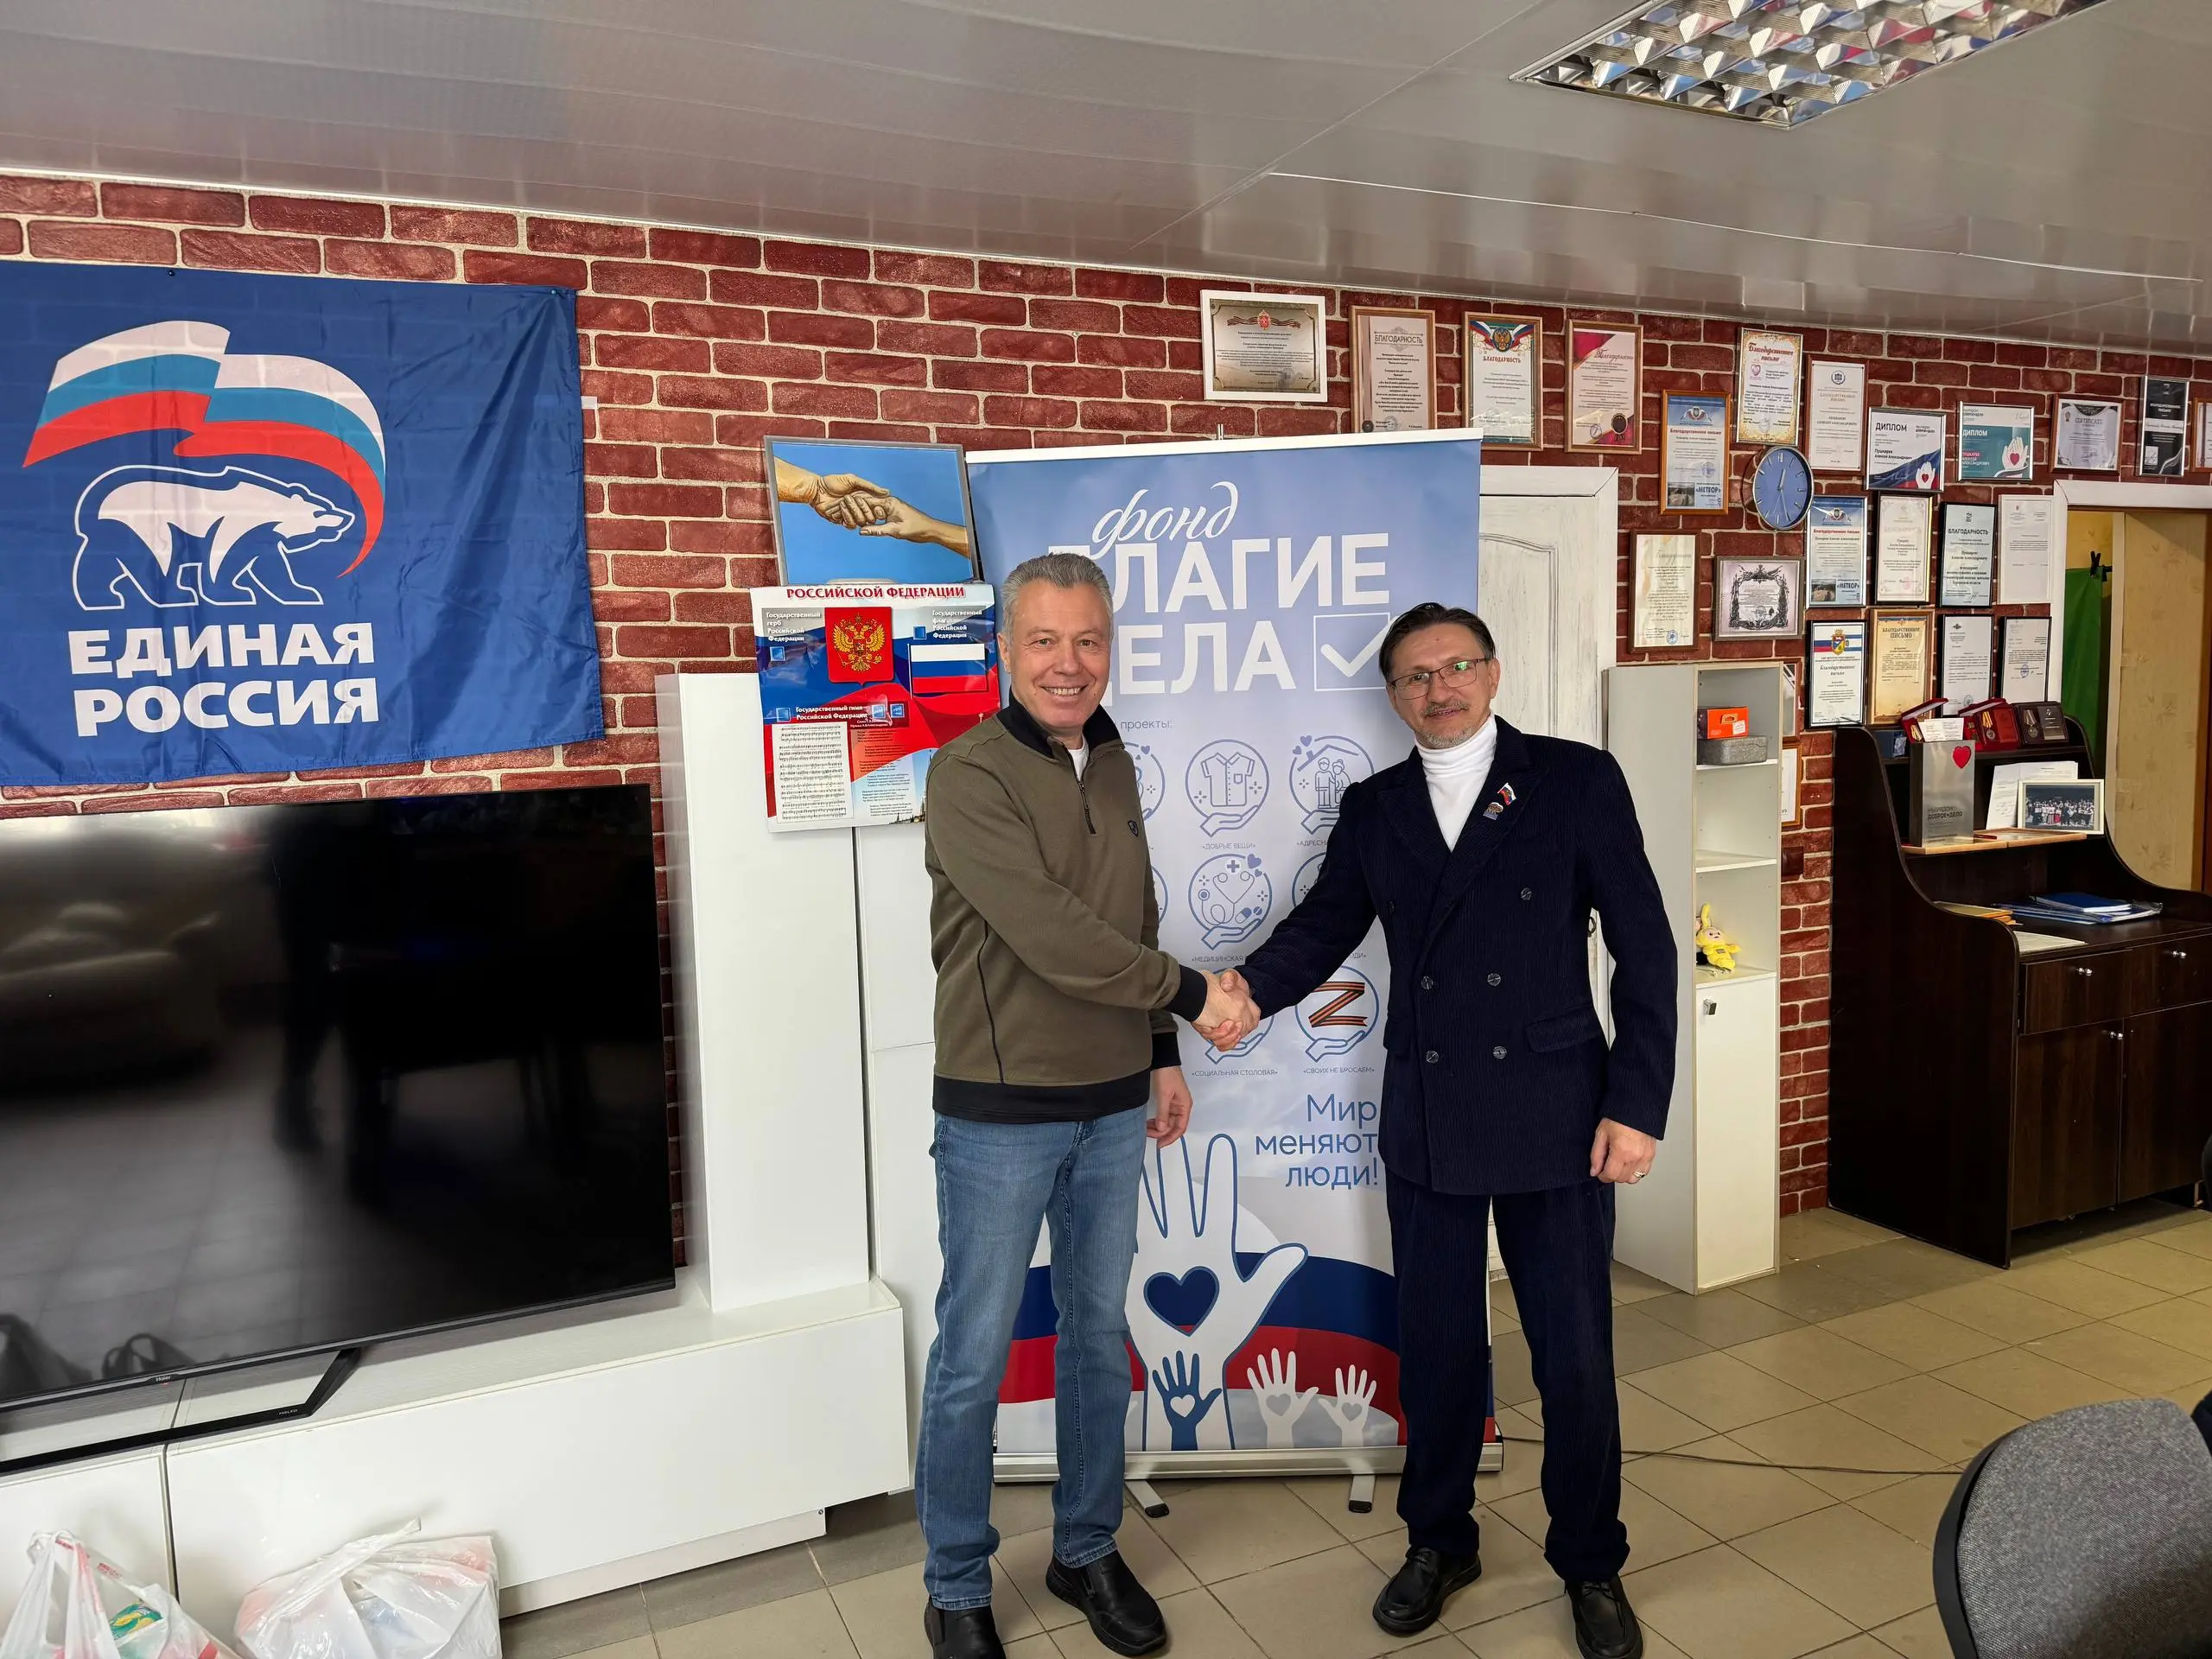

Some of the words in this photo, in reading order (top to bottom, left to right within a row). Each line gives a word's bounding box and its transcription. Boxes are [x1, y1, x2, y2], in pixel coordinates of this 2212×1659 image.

[1374, 334, 1423, 344] БЛАГОДАРНОСТЬ
[1875, 423, 1907, 432] ДИПЛОМ
[1962, 429, 1988, 437] ДИПЛОМ
[1090, 481, 1239, 560] фонд
[1049, 532, 1389, 613] ЛАГИЕ
[786, 586, 883, 599] РОССИЙСКОЙ
[887, 586, 965, 599] ФЕДЕРАЦИИ
[68, 622, 375, 678] ЕДИНАЯ
[1100, 620, 1297, 707] ЕЛА
[73, 677, 379, 737] РОССИЯ
[1120, 719, 1174, 732] проекты:
[1306, 1093, 1377, 1129] Мир
[1255, 1133, 1378, 1155] меняют
[1285, 1157, 1378, 1191] люди!
